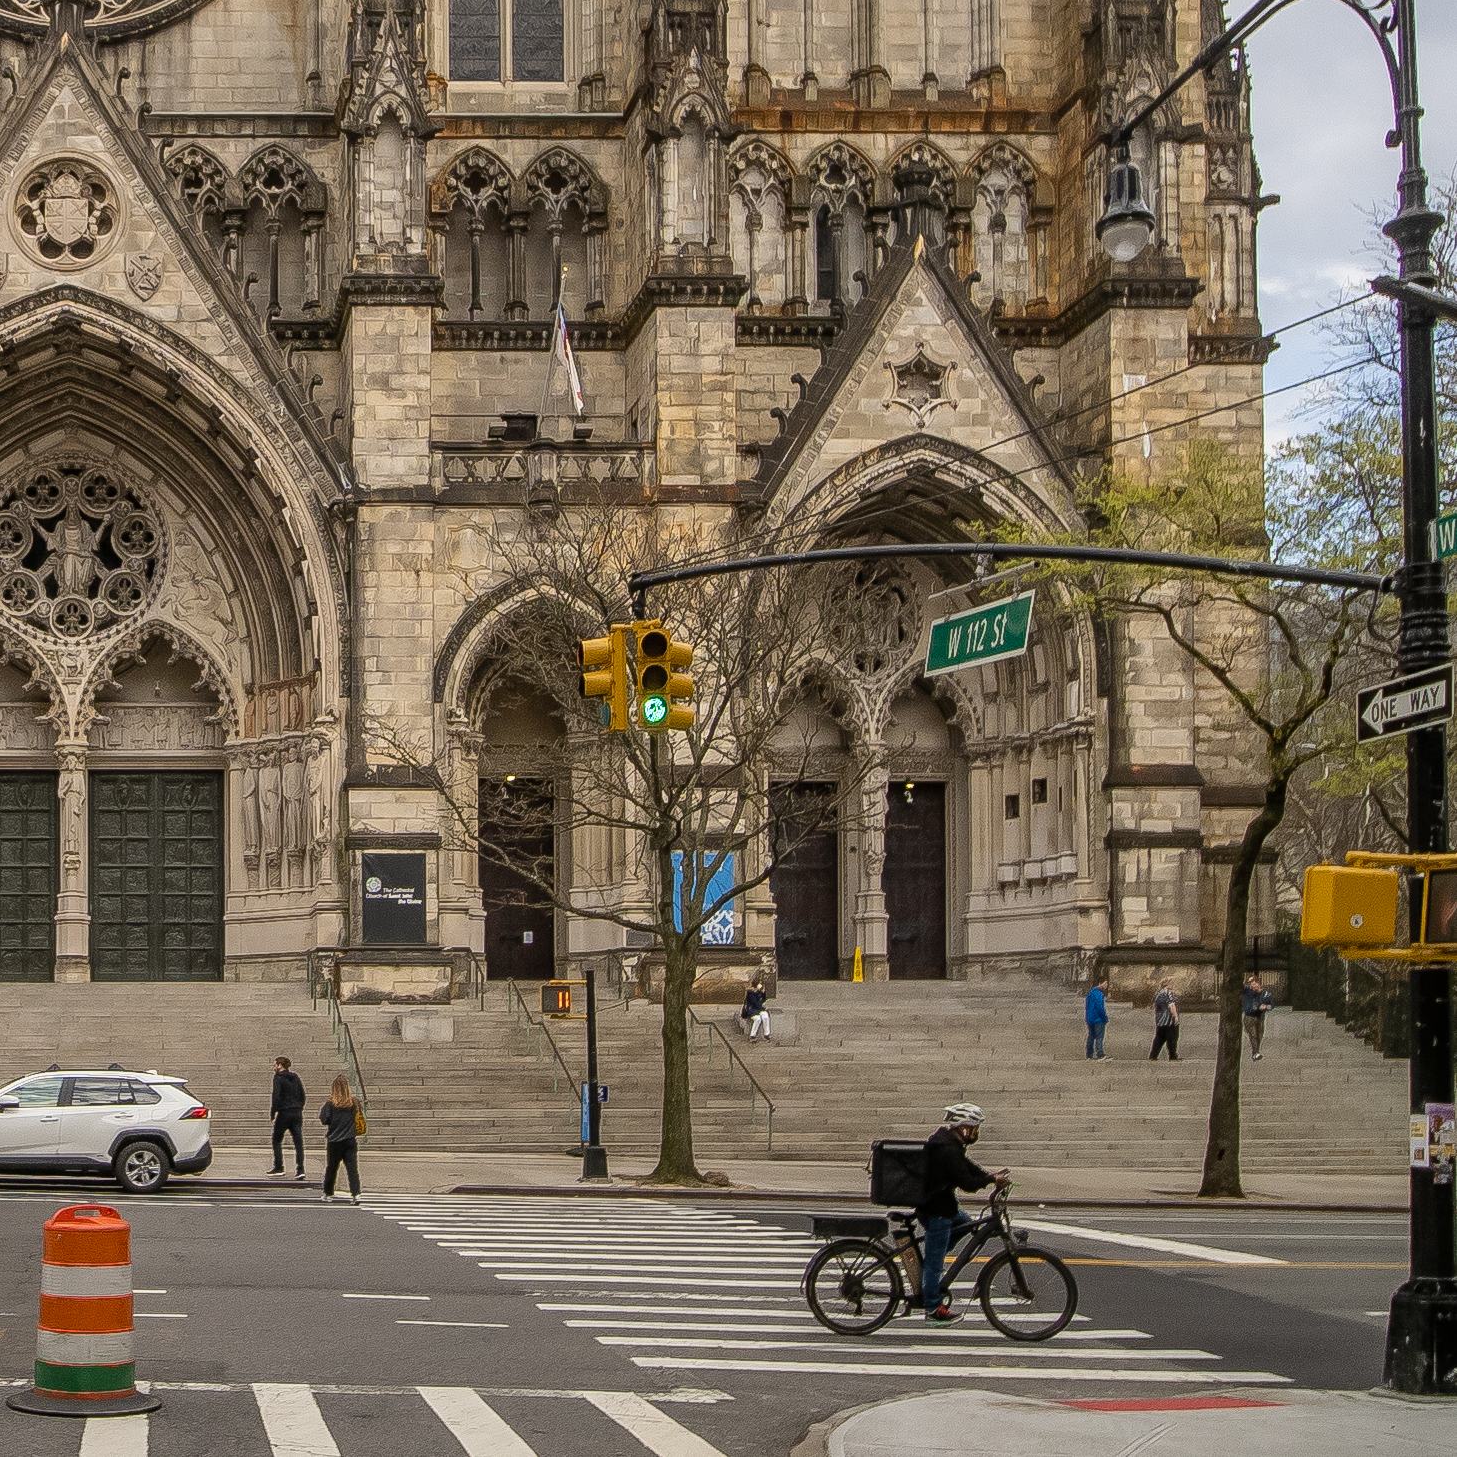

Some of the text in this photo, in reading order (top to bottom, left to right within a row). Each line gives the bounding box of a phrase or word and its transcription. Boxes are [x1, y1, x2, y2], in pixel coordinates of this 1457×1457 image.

[1439, 518, 1456, 553] W
[948, 610, 1008, 660] W 112 St
[1370, 684, 1440, 724] ONE WAY
